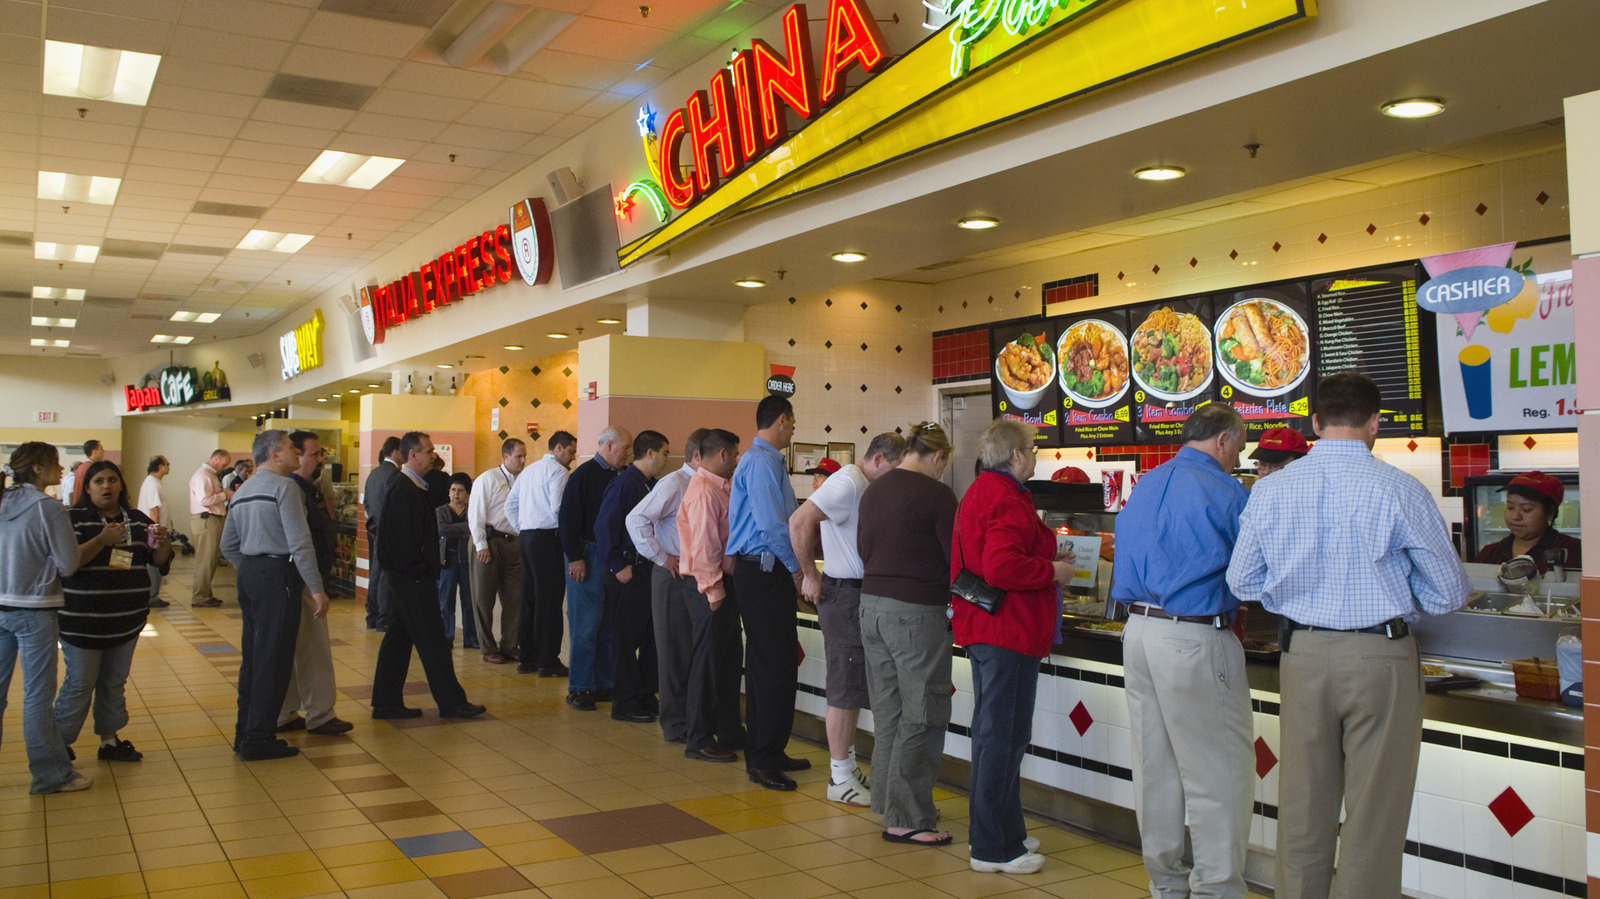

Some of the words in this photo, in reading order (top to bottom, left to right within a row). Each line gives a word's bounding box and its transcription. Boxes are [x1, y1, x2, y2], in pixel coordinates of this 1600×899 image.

[660, 0, 868, 210] CHINA
[374, 271, 418, 331] ITALIA
[420, 224, 512, 312] EXPRESS
[1425, 275, 1511, 304] CASHIER
[280, 310, 321, 381] SUBWAY
[1509, 342, 1576, 388] LEM
[768, 380, 782, 391] ORDER
[783, 382, 794, 393] HERE
[1223, 388, 1230, 396] 4
[124, 385, 161, 412] Japan
[204, 389, 218, 400] GRILL
[1138, 392, 1143, 401] 3
[1066, 398, 1071, 407] 2
[1266, 399, 1287, 414] Plate
[1290, 402, 1307, 412] 5.29
[39, 412, 51, 420] EXIT
[1064, 412, 1070, 423] 2
[1072, 410, 1087, 422] Item
[1089, 409, 1114, 422] Combo
[1116, 410, 1128, 418] 5.69
[1137, 406, 1142, 418] 3
[1146, 404, 1163, 418] Item
[1165, 401, 1194, 416] Combo
[1523, 408, 1550, 418] Reg.
[1024, 412, 1042, 424] Bowl
